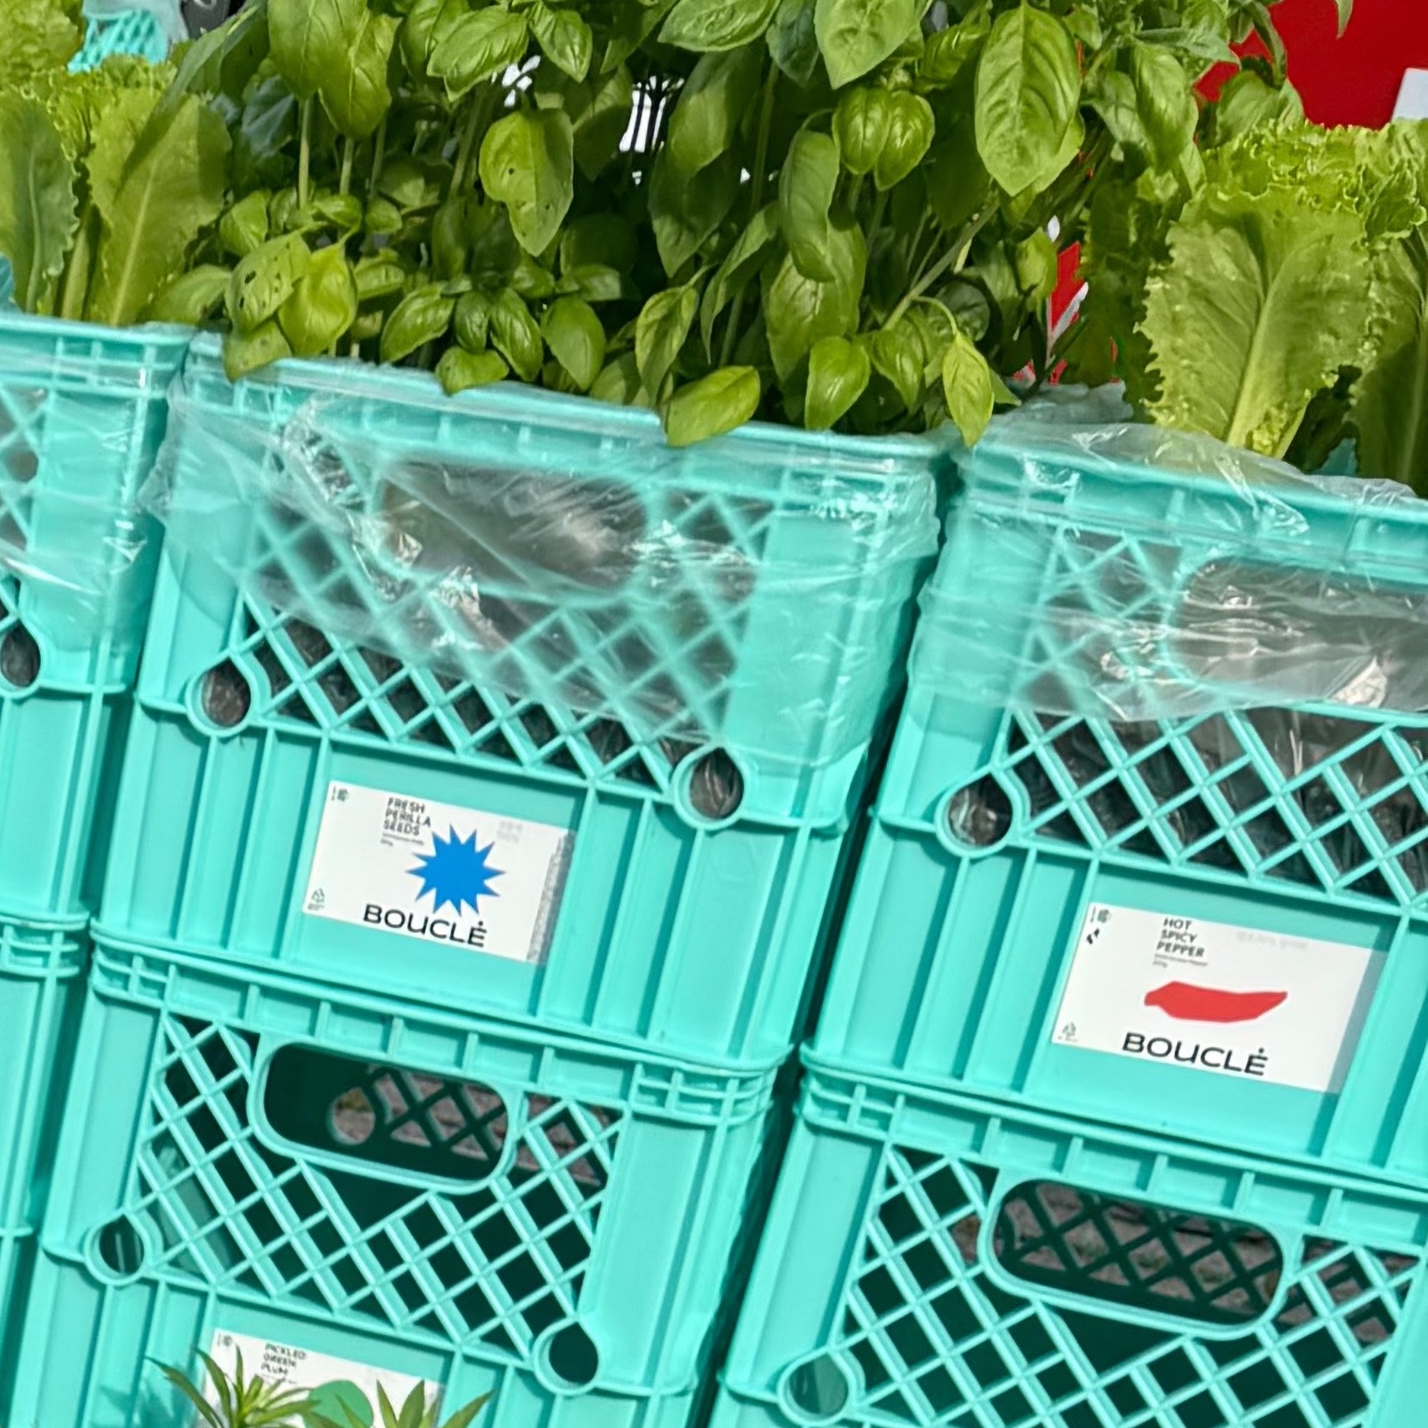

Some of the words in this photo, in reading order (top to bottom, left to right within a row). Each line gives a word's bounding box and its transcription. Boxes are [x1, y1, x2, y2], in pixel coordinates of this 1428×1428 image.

[387, 796, 425, 814] FRESH
[384, 808, 432, 828] PERILLA
[383, 819, 421, 837] SEEDS
[1162, 917, 1193, 932] HOT
[1160, 929, 1198, 944] SPICY
[1155, 941, 1206, 959] PEPPER
